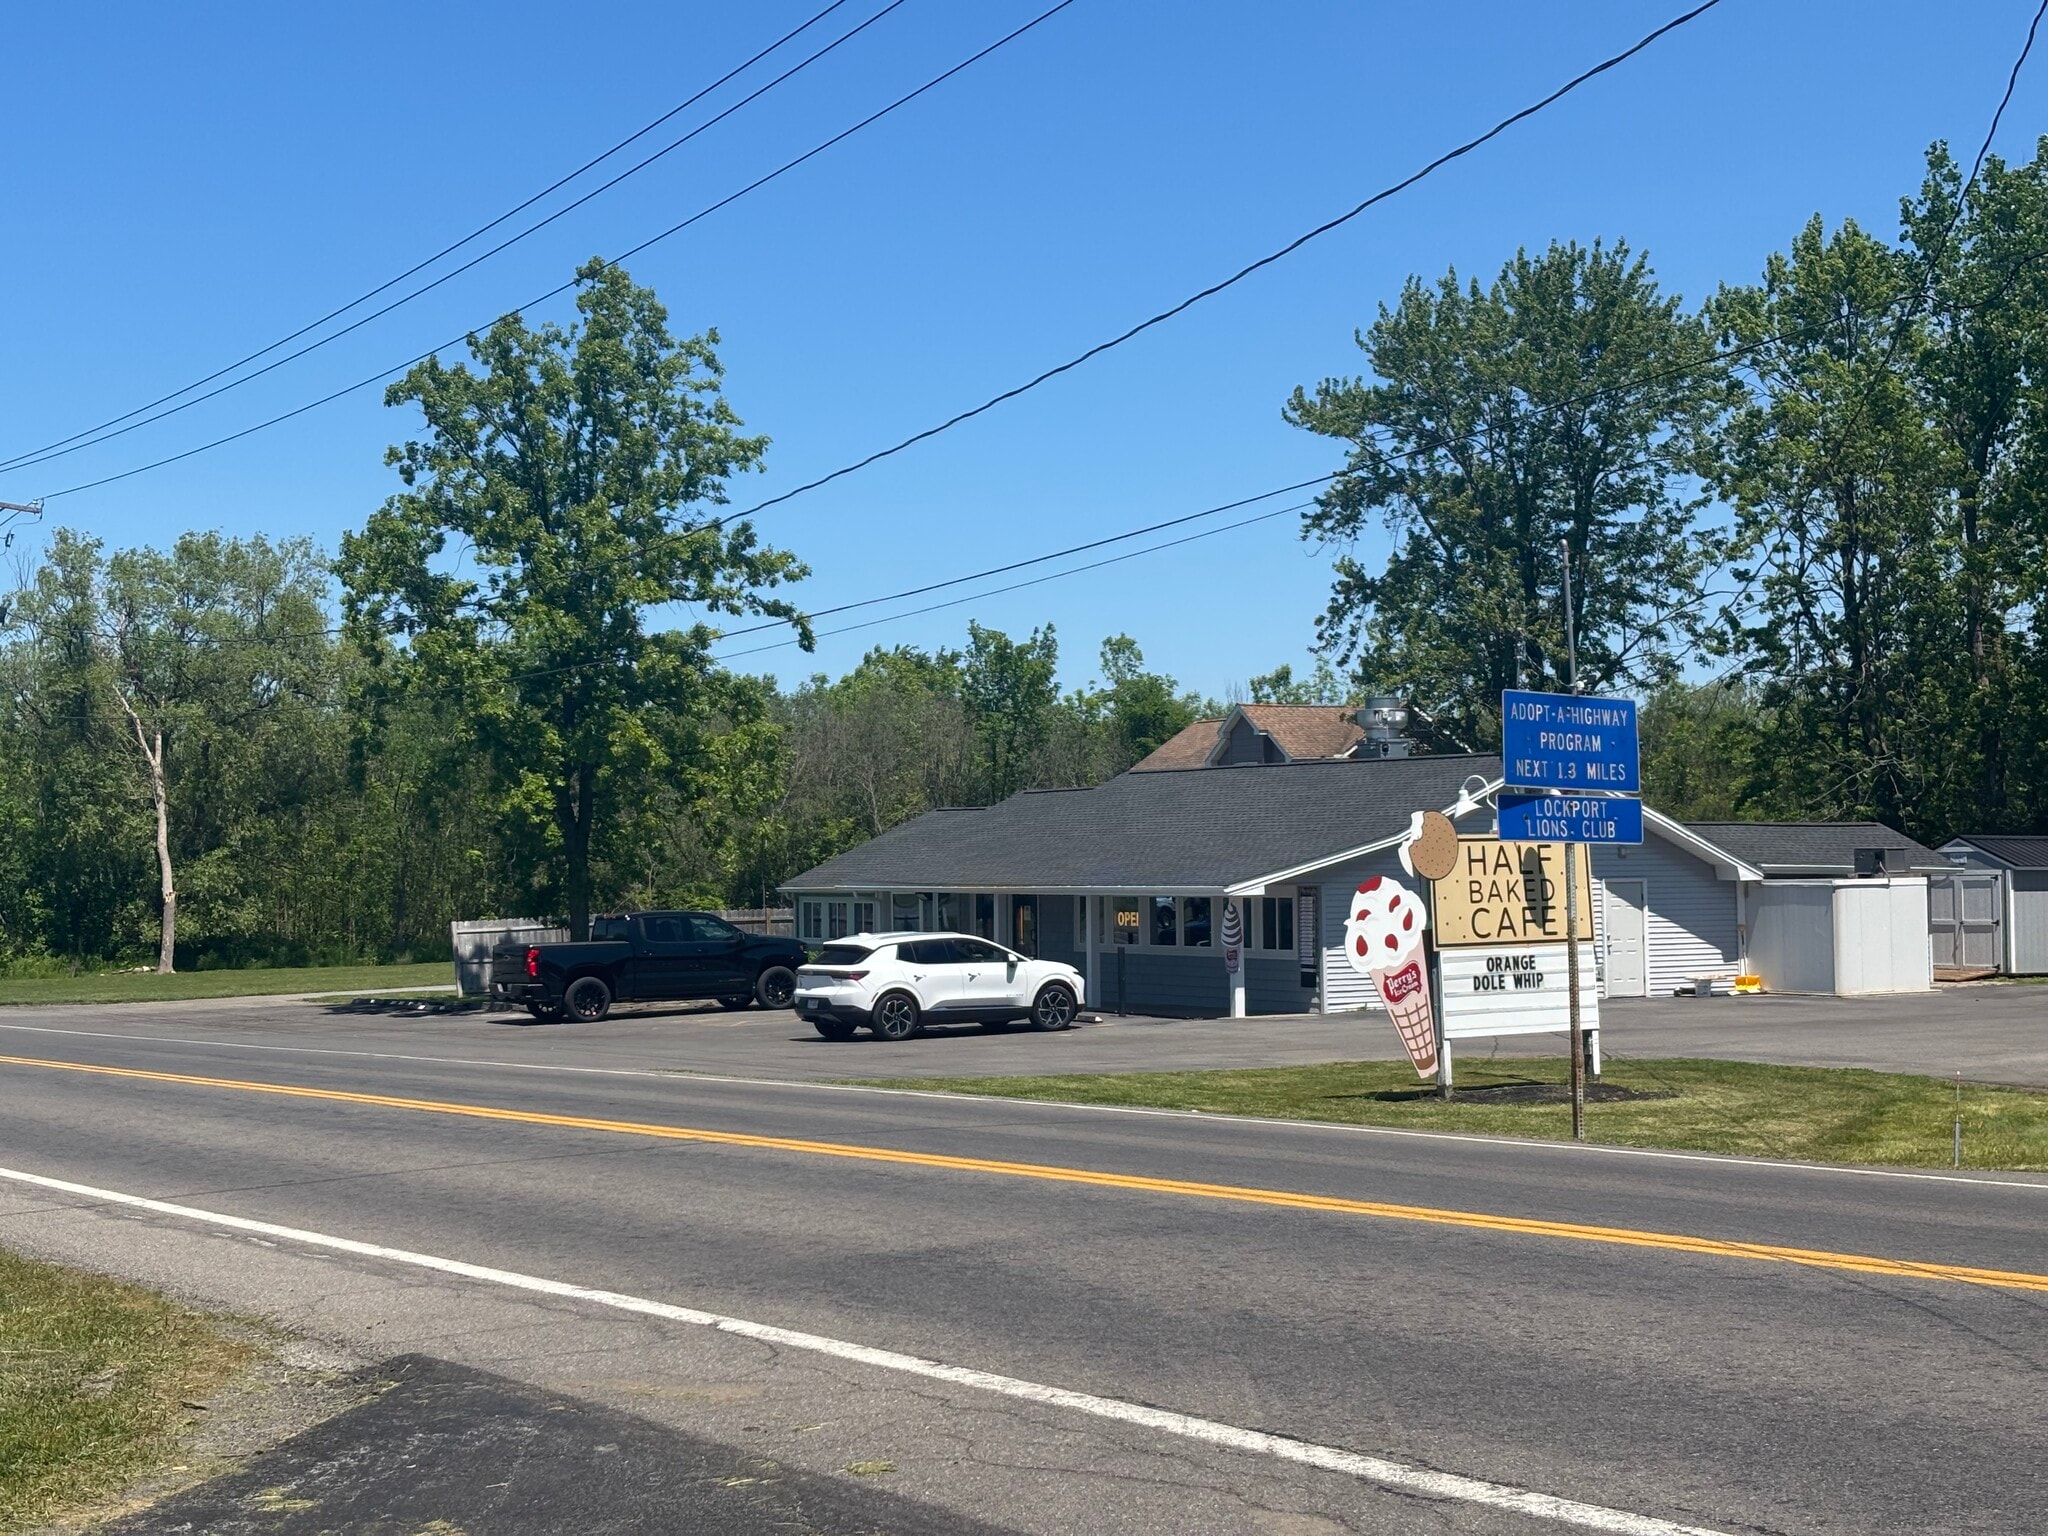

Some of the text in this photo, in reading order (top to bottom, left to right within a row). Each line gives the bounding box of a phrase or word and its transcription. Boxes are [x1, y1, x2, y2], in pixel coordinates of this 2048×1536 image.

[1511, 702, 1627, 727] ADOPT-A-HIGHWAY
[1540, 732, 1601, 752] PROGRAM
[1516, 759, 1626, 781] NEXT 1.3 MILES
[1535, 799, 1607, 819] LOCKPORT
[1527, 819, 1616, 839] LIONS CLUB
[1467, 843, 1552, 876] HALF
[1469, 878, 1555, 904] BAKED
[1471, 905, 1558, 939] CAFE
[1486, 955, 1536, 972] ORANGE
[1386, 969, 1417, 996] Perry's
[1473, 973, 1544, 991] DOLE WHIP
